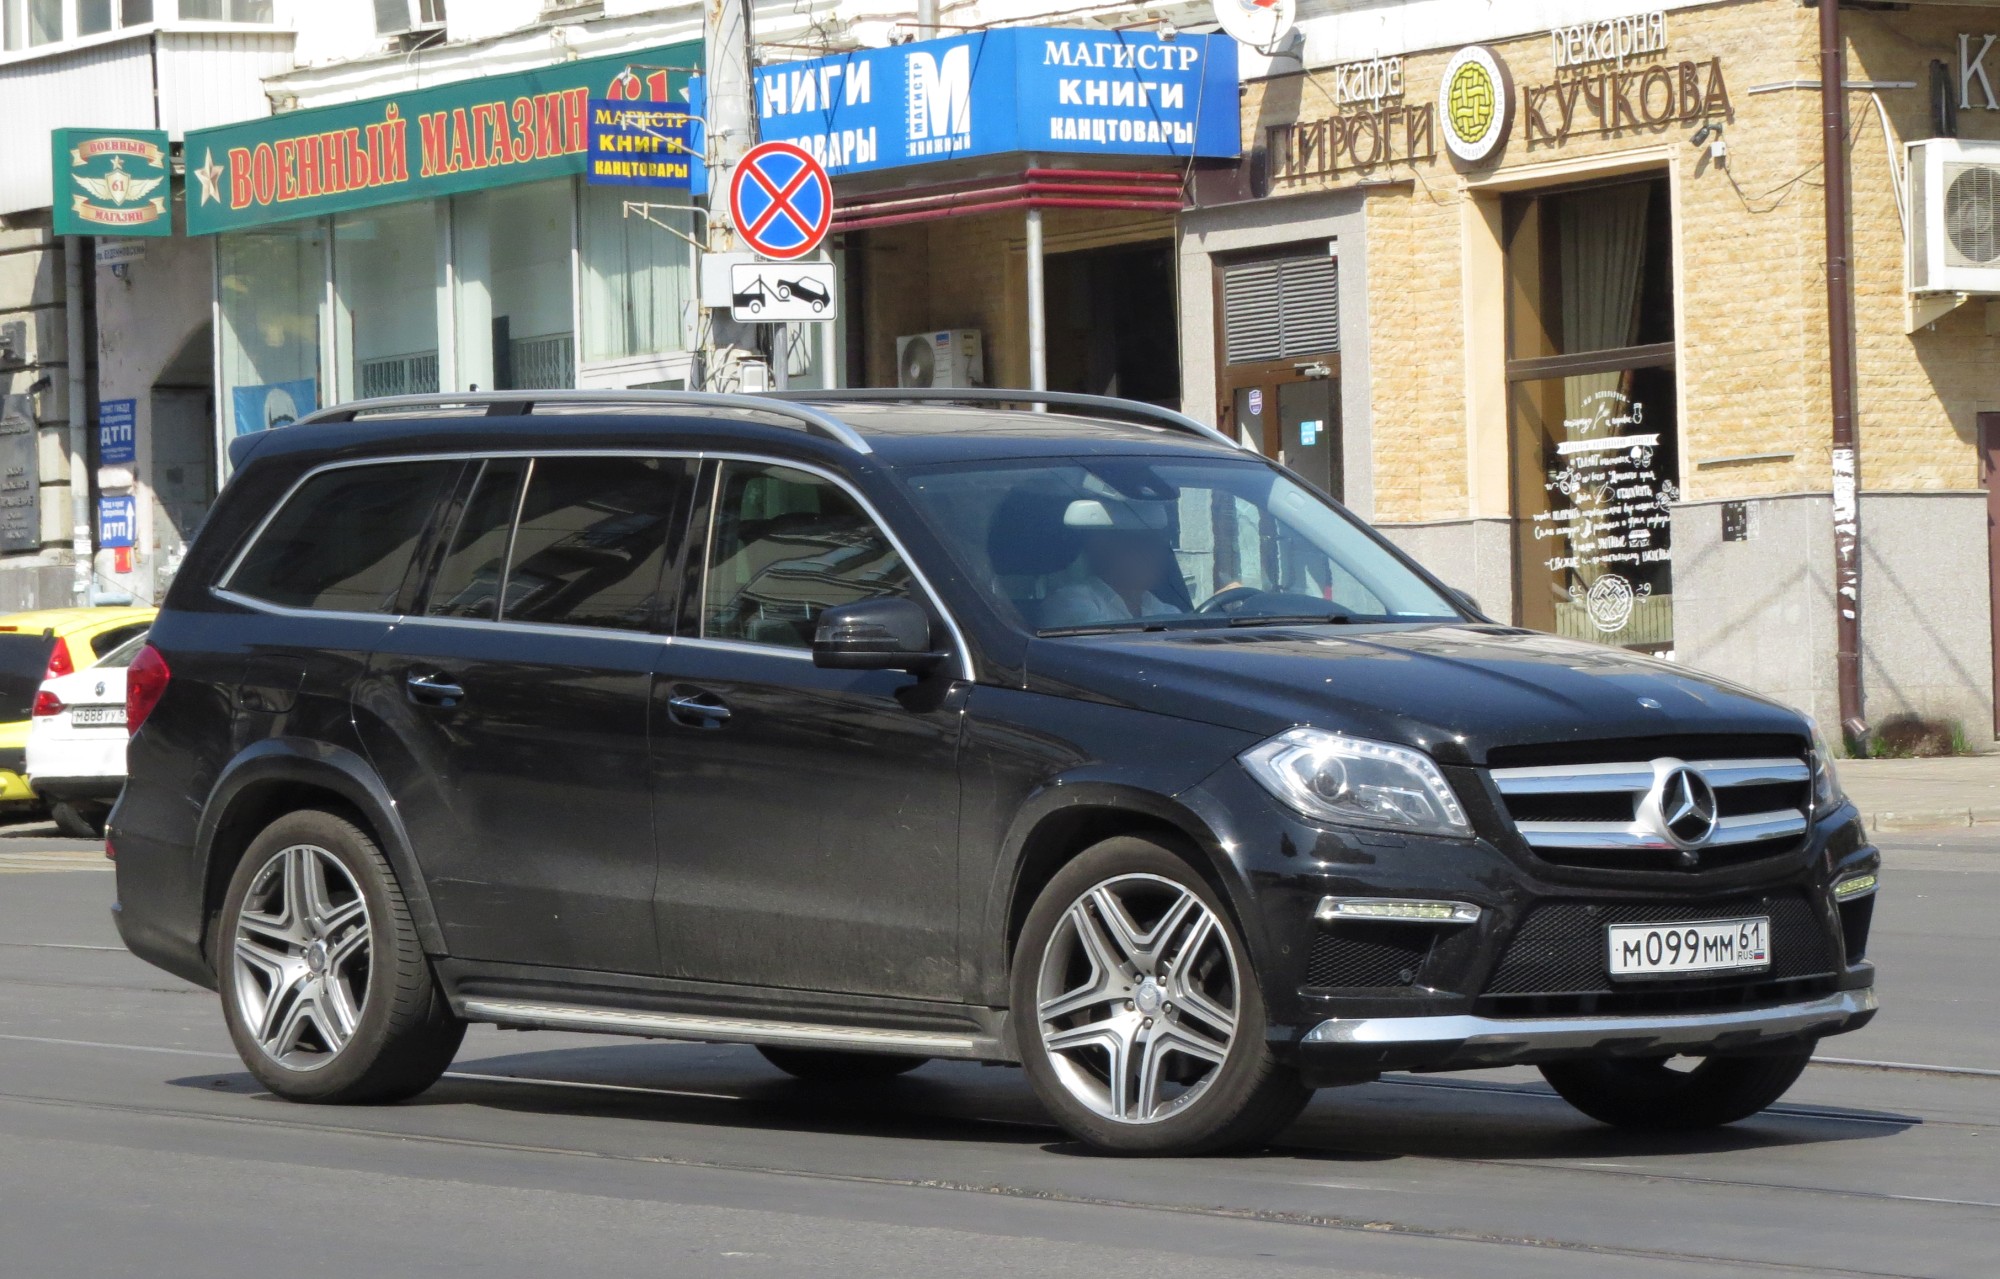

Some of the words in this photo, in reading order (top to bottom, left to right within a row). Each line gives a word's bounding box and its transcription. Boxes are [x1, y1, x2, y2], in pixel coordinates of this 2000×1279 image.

[1551, 10, 1666, 70] пекарня
[1043, 40, 1198, 71] МАГИСТР
[754, 60, 870, 119] НИГИ
[1059, 79, 1184, 109] КНИГИ
[1335, 48, 1400, 112] кафе
[913, 62, 923, 133] МАГИСТР
[1523, 56, 1733, 143] КУЧКОВА
[595, 109, 688, 128] МАГИСТР
[1050, 117, 1193, 144] КАНЦТОВАРЫ
[89, 141, 146, 154] ВОЕННЫЙ
[228, 102, 408, 211] ВОЕННЫЙ
[419, 87, 588, 178] МАГАЗИН
[600, 134, 683, 154] КНИГИ
[787, 126, 876, 168] ОВАРЫ
[910, 133, 971, 157] КНИЖНЫЙ
[1266, 102, 1435, 179] ПИРОГИ
[595, 160, 688, 178] КАНЦТОВАРЫ
[112, 180, 124, 192] 61
[95, 210, 143, 222] МАГАЗИН
[100, 424, 131, 446] ДТП
[103, 522, 125, 540] ДТП
[1623, 929, 1733, 967] М099ММ
[1739, 922, 1760, 950] 61
[1738, 949, 1753, 960] RUS
